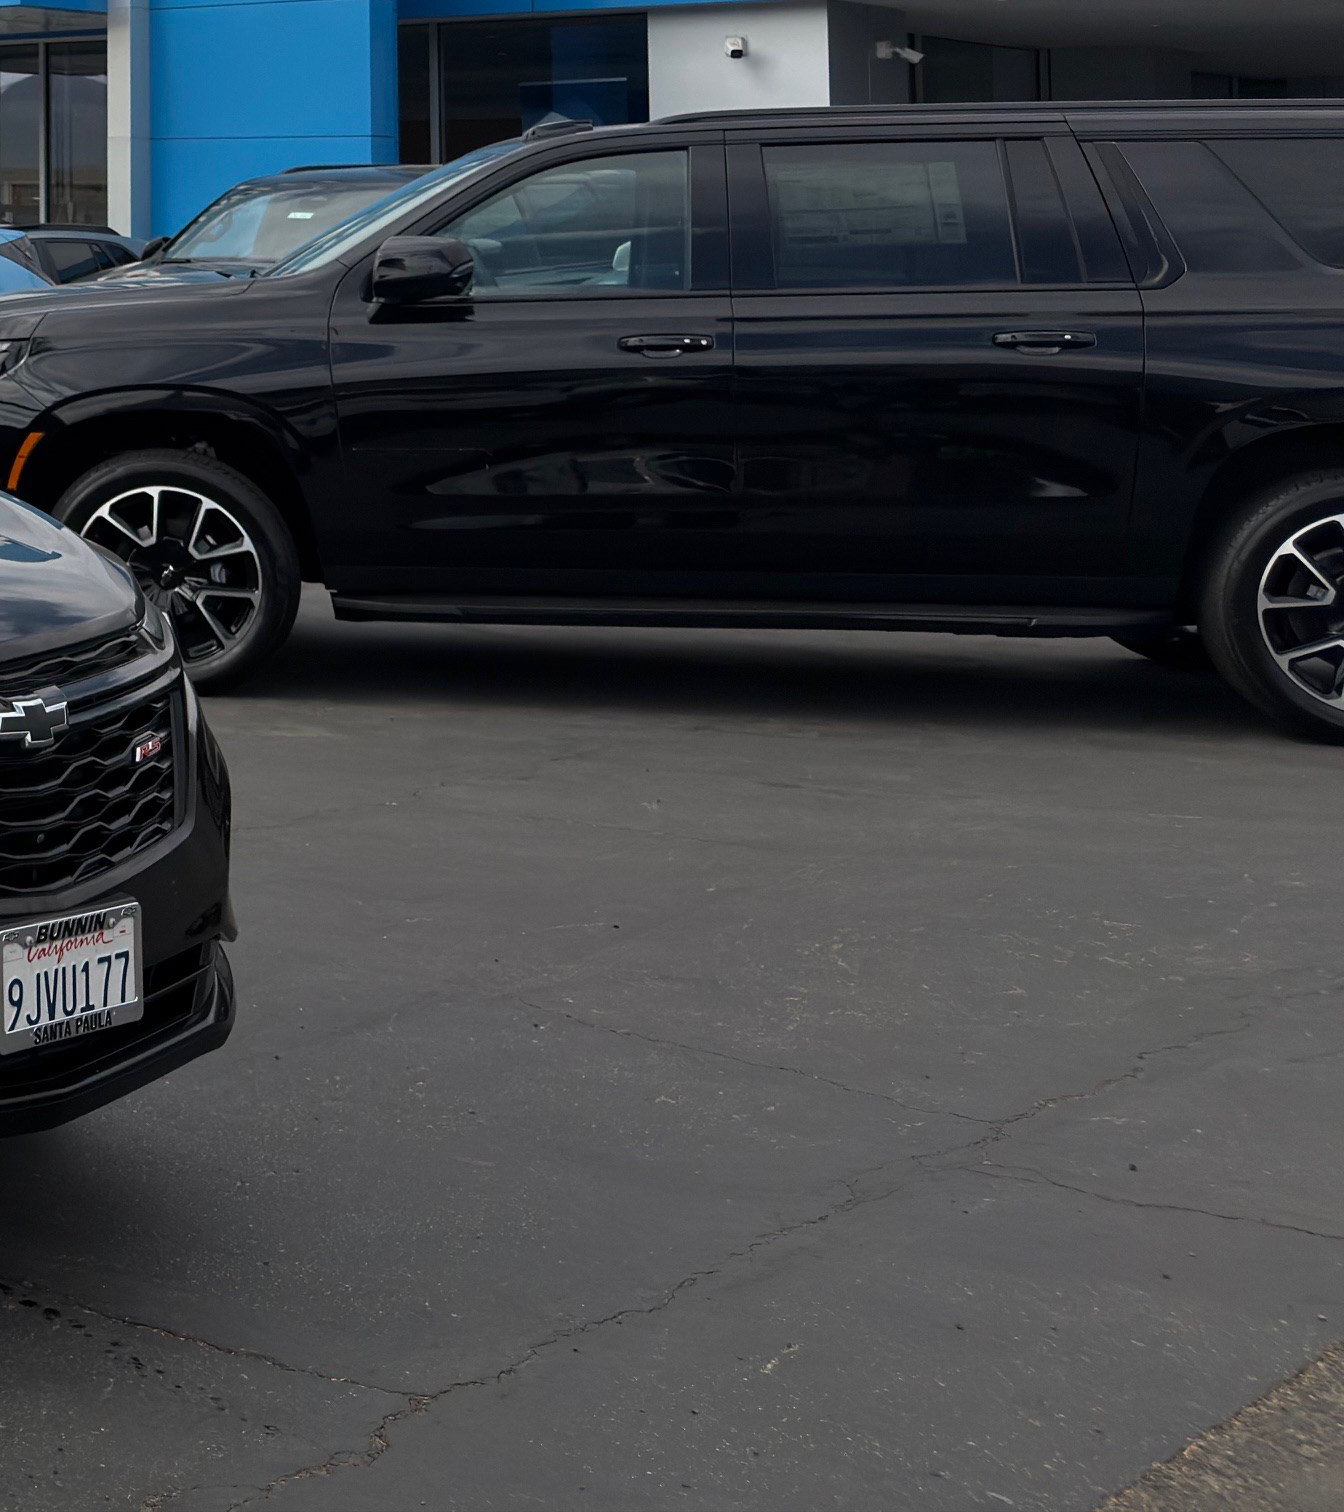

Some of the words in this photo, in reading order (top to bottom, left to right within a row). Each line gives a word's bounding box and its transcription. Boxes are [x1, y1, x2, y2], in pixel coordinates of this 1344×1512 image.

[135, 736, 161, 761] RS
[36, 912, 108, 944] BUNNIN
[27, 930, 113, 963] California
[8, 950, 130, 1032] 9JVU177
[34, 1019, 72, 1045] SANTA
[75, 1010, 113, 1035] PAULA
